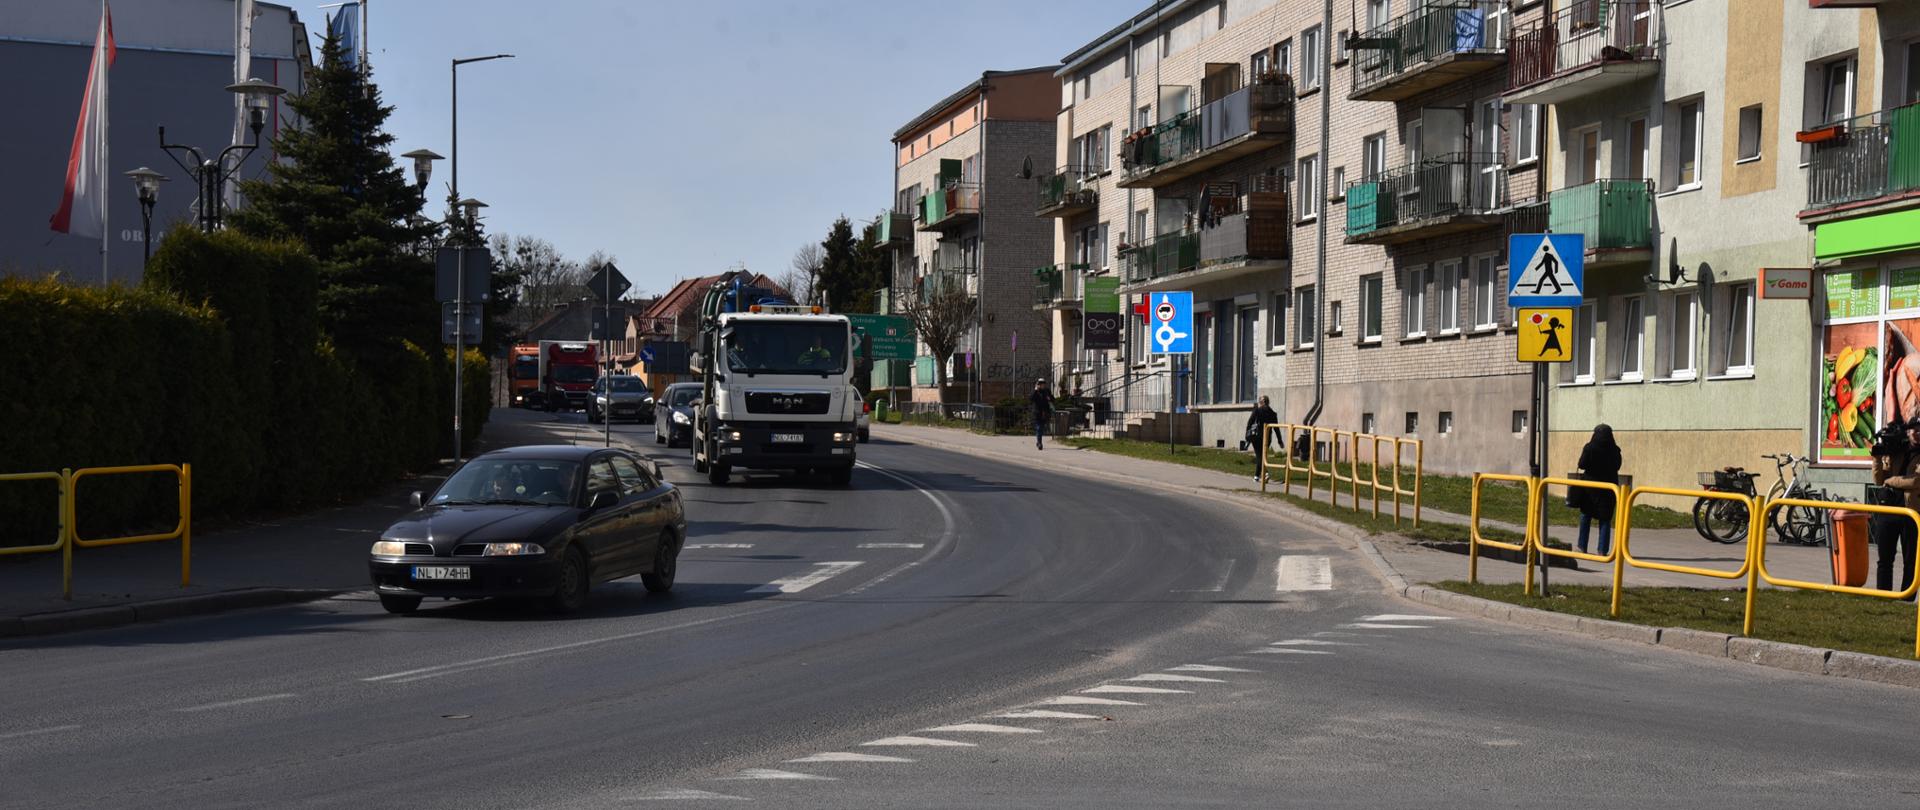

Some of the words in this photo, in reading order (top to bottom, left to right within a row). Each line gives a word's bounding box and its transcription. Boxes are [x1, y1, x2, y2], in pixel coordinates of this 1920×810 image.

[1778, 278, 1808, 289] Gama
[772, 397, 803, 405] MAN
[443, 567, 469, 579] 74HH
